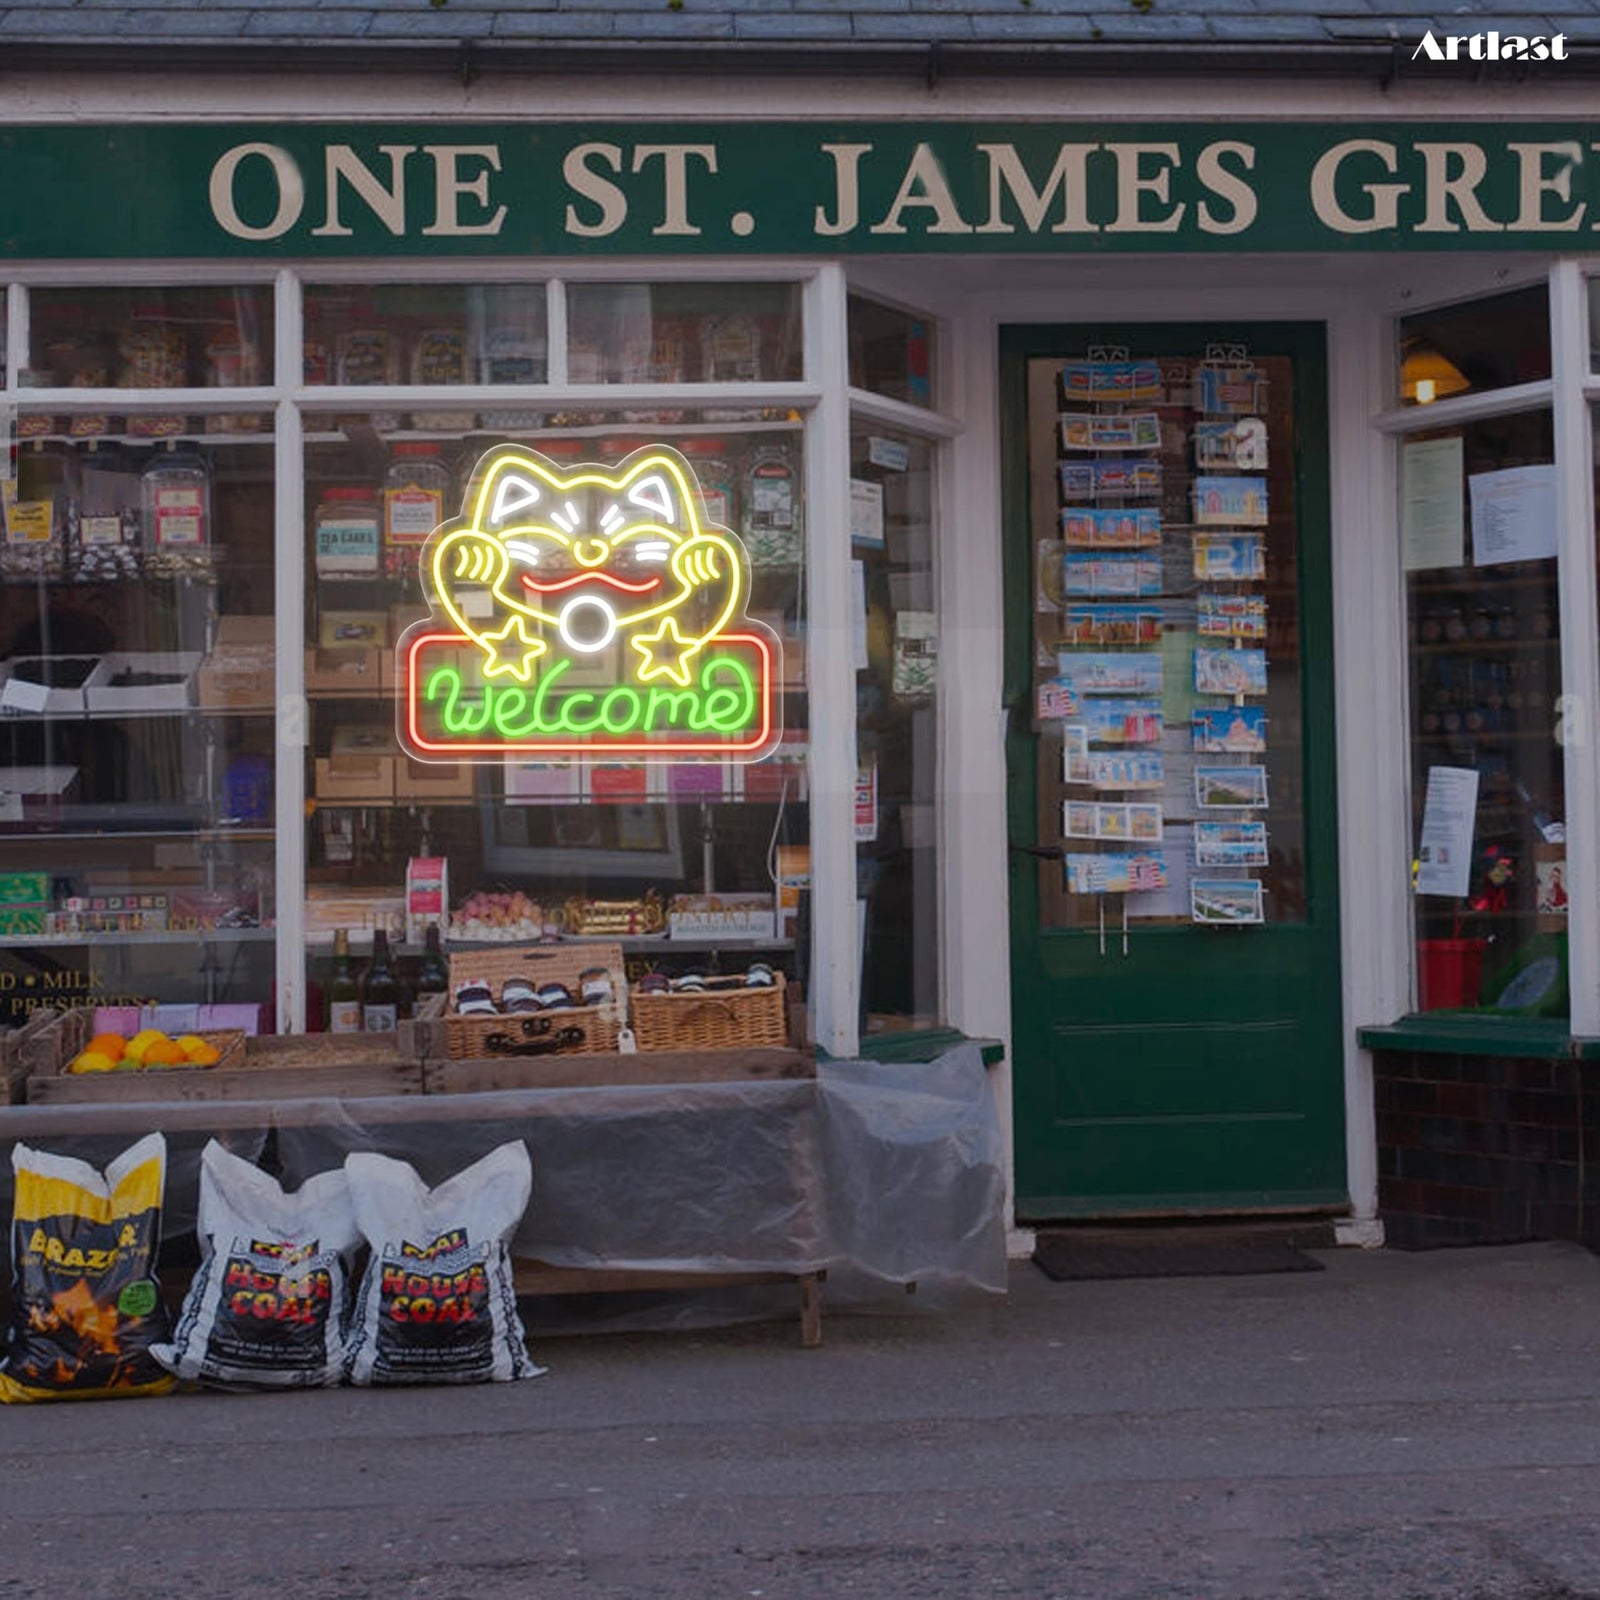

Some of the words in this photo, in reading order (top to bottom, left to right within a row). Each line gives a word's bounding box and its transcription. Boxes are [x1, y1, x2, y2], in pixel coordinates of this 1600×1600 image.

[208, 142, 508, 241] ONE
[562, 142, 757, 238] ST.
[813, 140, 1259, 236] JAMES
[1310, 139, 1600, 235] GRE
[426, 658, 756, 738] welcome
[42, 969, 105, 990] MILK
[225, 1262, 330, 1300] HOUSE
[383, 1266, 486, 1299] HOUSE
[230, 1291, 318, 1326] COAL
[389, 1296, 478, 1324] COAL
